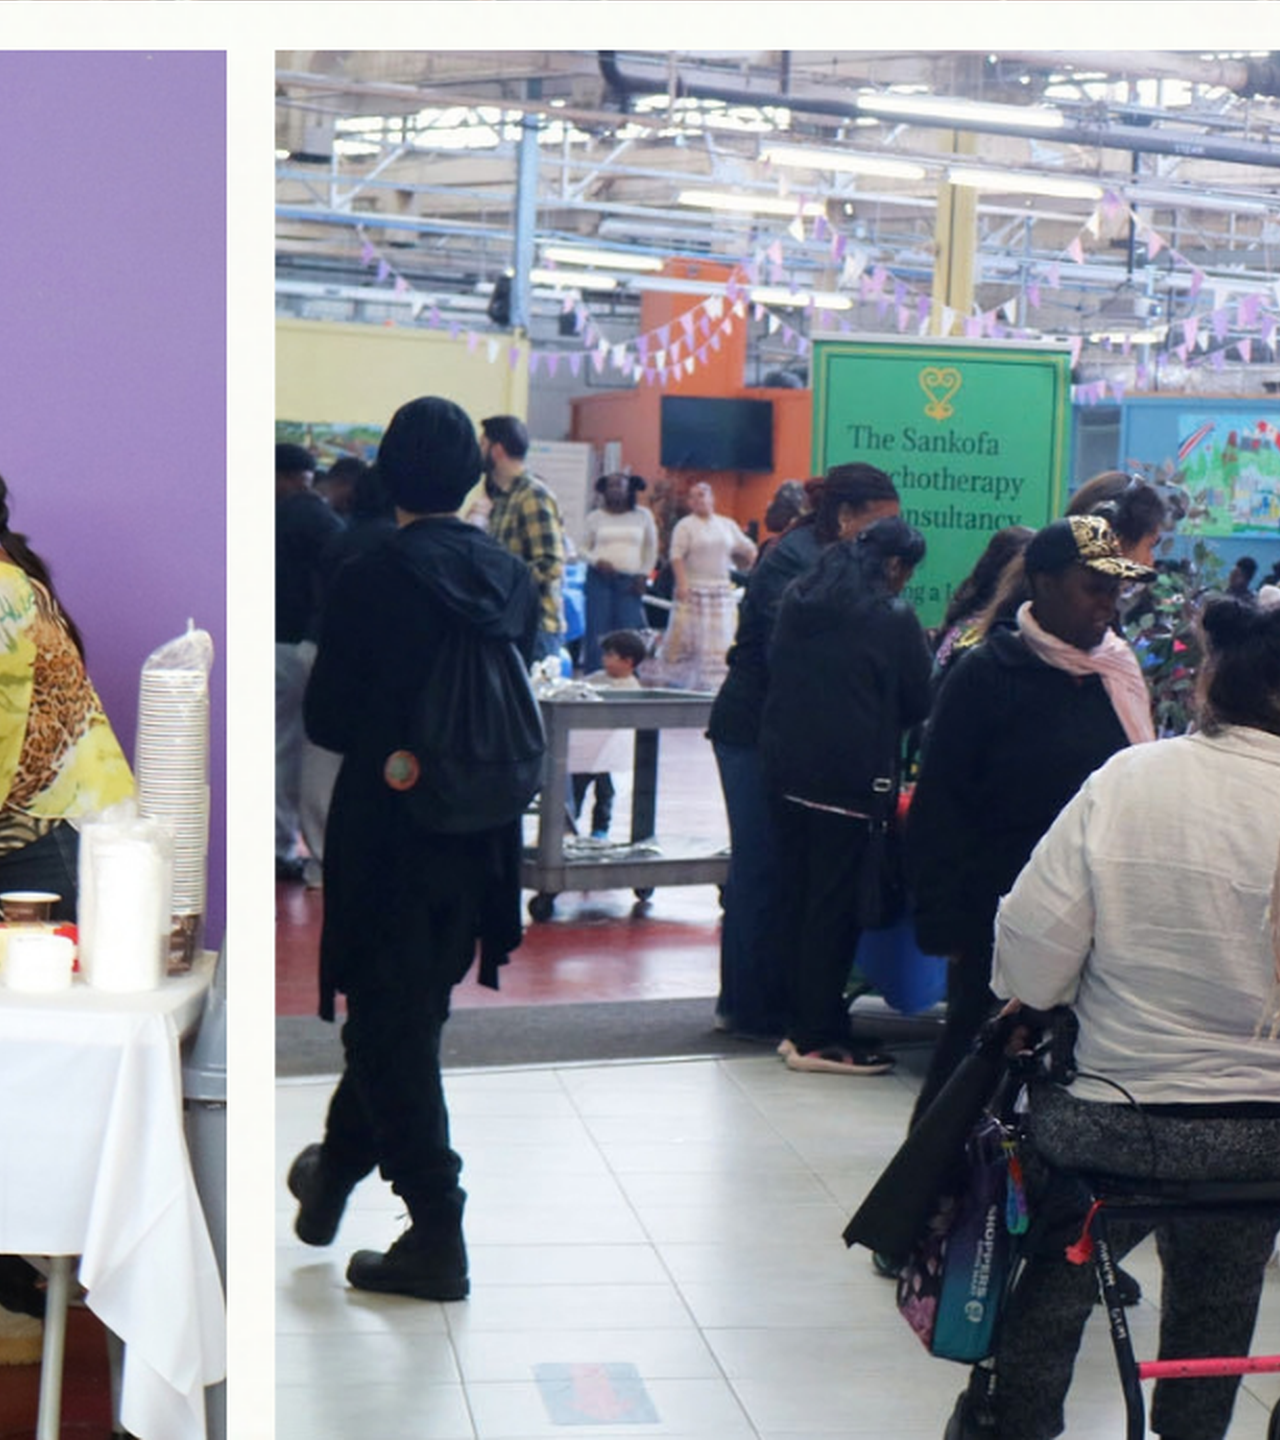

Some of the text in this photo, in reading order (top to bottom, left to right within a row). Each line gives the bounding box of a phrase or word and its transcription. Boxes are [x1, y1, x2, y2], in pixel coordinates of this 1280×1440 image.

[847, 424, 1000, 457] The Sankofa
[886, 464, 1024, 502] chotherapy
[902, 504, 1022, 532] nsultancy
